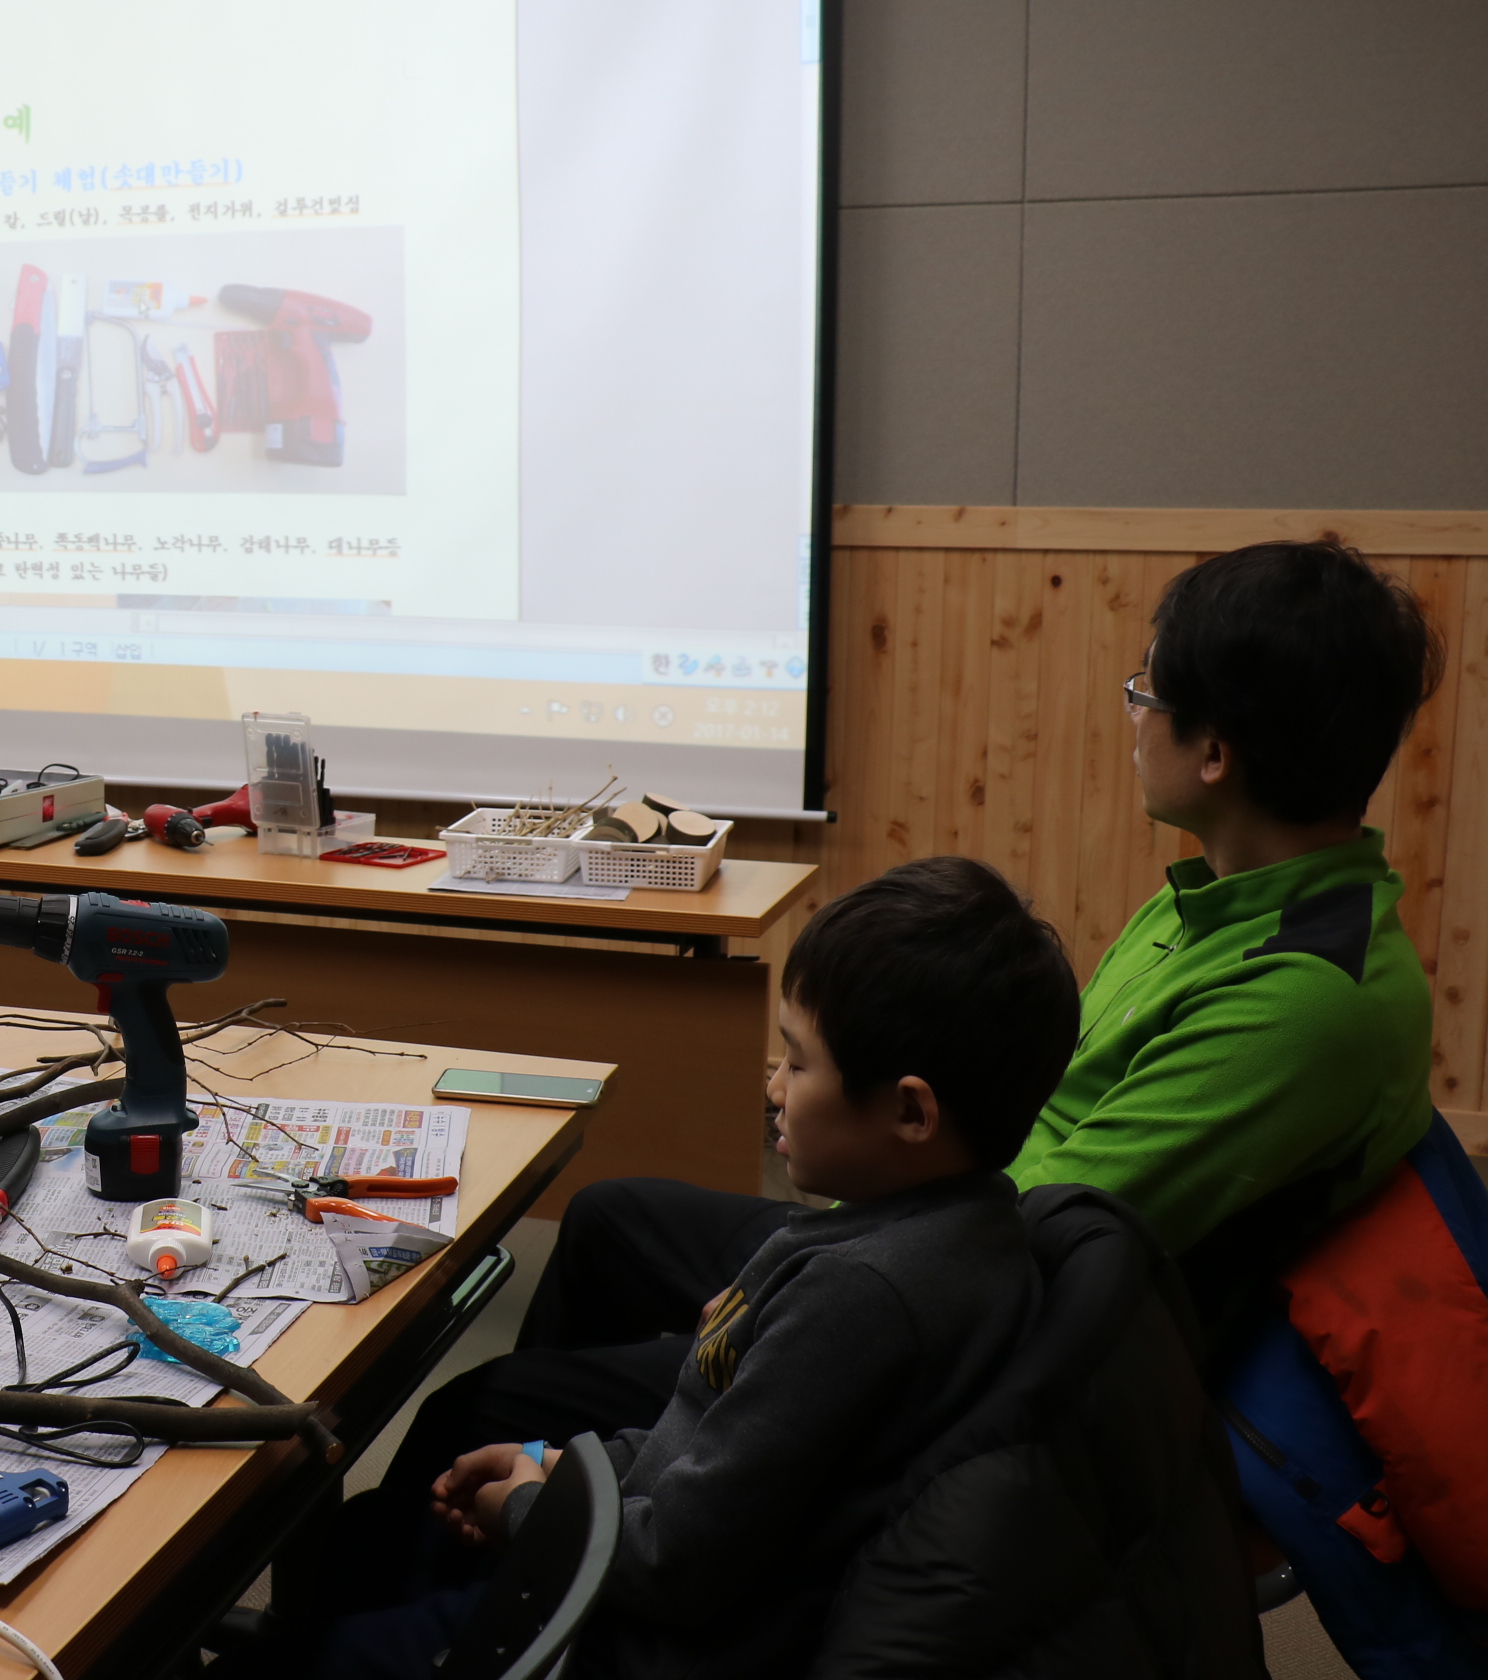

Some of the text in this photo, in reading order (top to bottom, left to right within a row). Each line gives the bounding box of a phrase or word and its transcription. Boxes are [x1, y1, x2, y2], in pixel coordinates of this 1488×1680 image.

[70, 561, 104, 581] 있는
[106, 926, 171, 949] BOSCH
[111, 947, 144, 957] GSR 7.2-2
[115, 955, 169, 966] PROFESSIONAL
